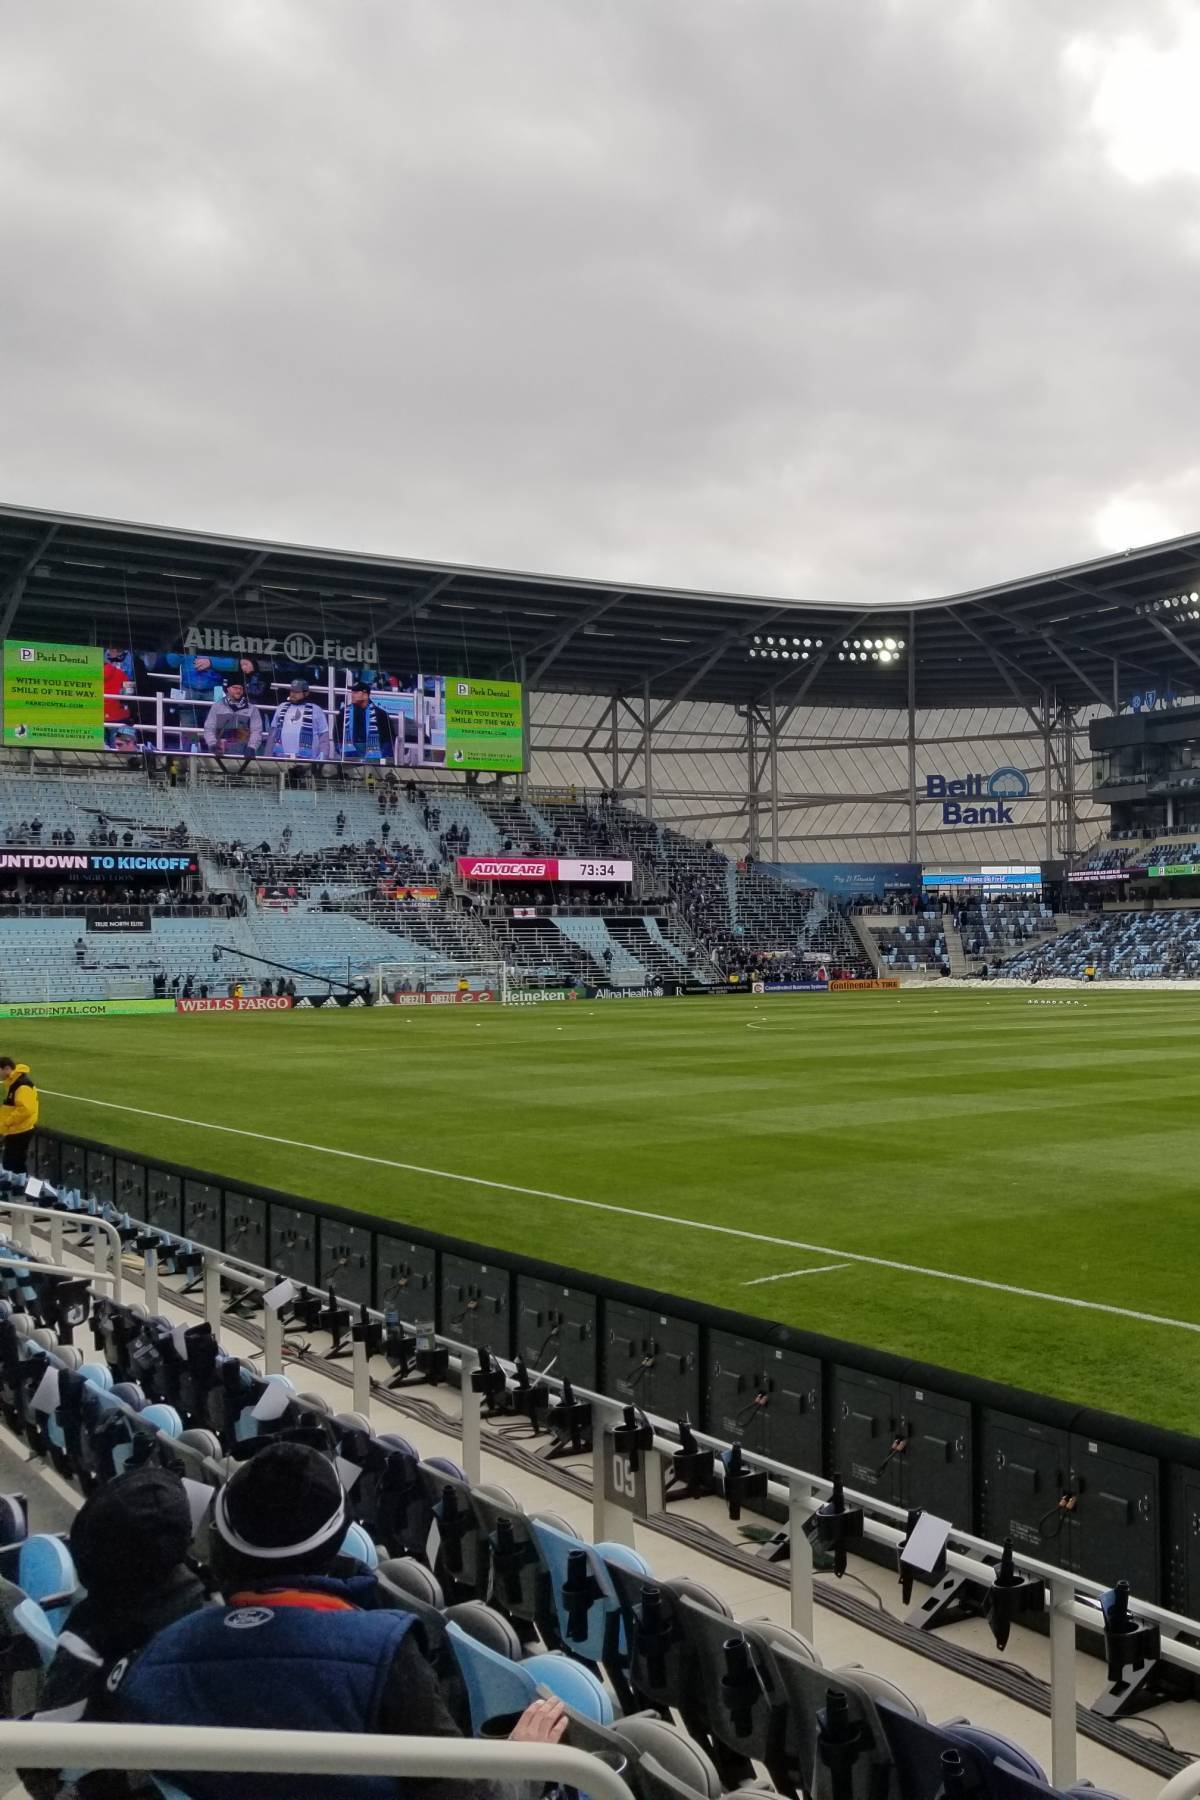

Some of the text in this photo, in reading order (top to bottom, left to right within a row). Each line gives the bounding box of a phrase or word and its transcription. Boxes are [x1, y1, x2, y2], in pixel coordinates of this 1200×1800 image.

[184, 626, 378, 664] Allianz Field
[37, 652, 57, 662] Park
[59, 653, 89, 664] Dental
[16, 677, 41, 685] WITH
[64, 680, 93, 689] EVERY
[11, 686, 39, 694] SMILE
[41, 688, 53, 696] OF
[56, 689, 73, 697] THE
[470, 687, 486, 697] Park
[487, 688, 511, 698] Dental
[454, 708, 473, 716] WITH
[491, 711, 514, 719] EVERY
[451, 717, 473, 725] SMILE
[927, 773, 982, 797] Bell
[943, 799, 1014, 825] Bank
[91, 856, 114, 869] TO
[471, 862, 546, 876] ADVOCARE
[580, 864, 615, 876] 73:34
[830, 980, 874, 991] Continental
[502, 990, 566, 1003] Heineken
[595, 987, 653, 999] Allina Health
[181, 997, 289, 1012] WELLS FARGO
[9, 1005, 107, 1017] PARKDENTAL.COM
[613, 1454, 636, 1498] 09
